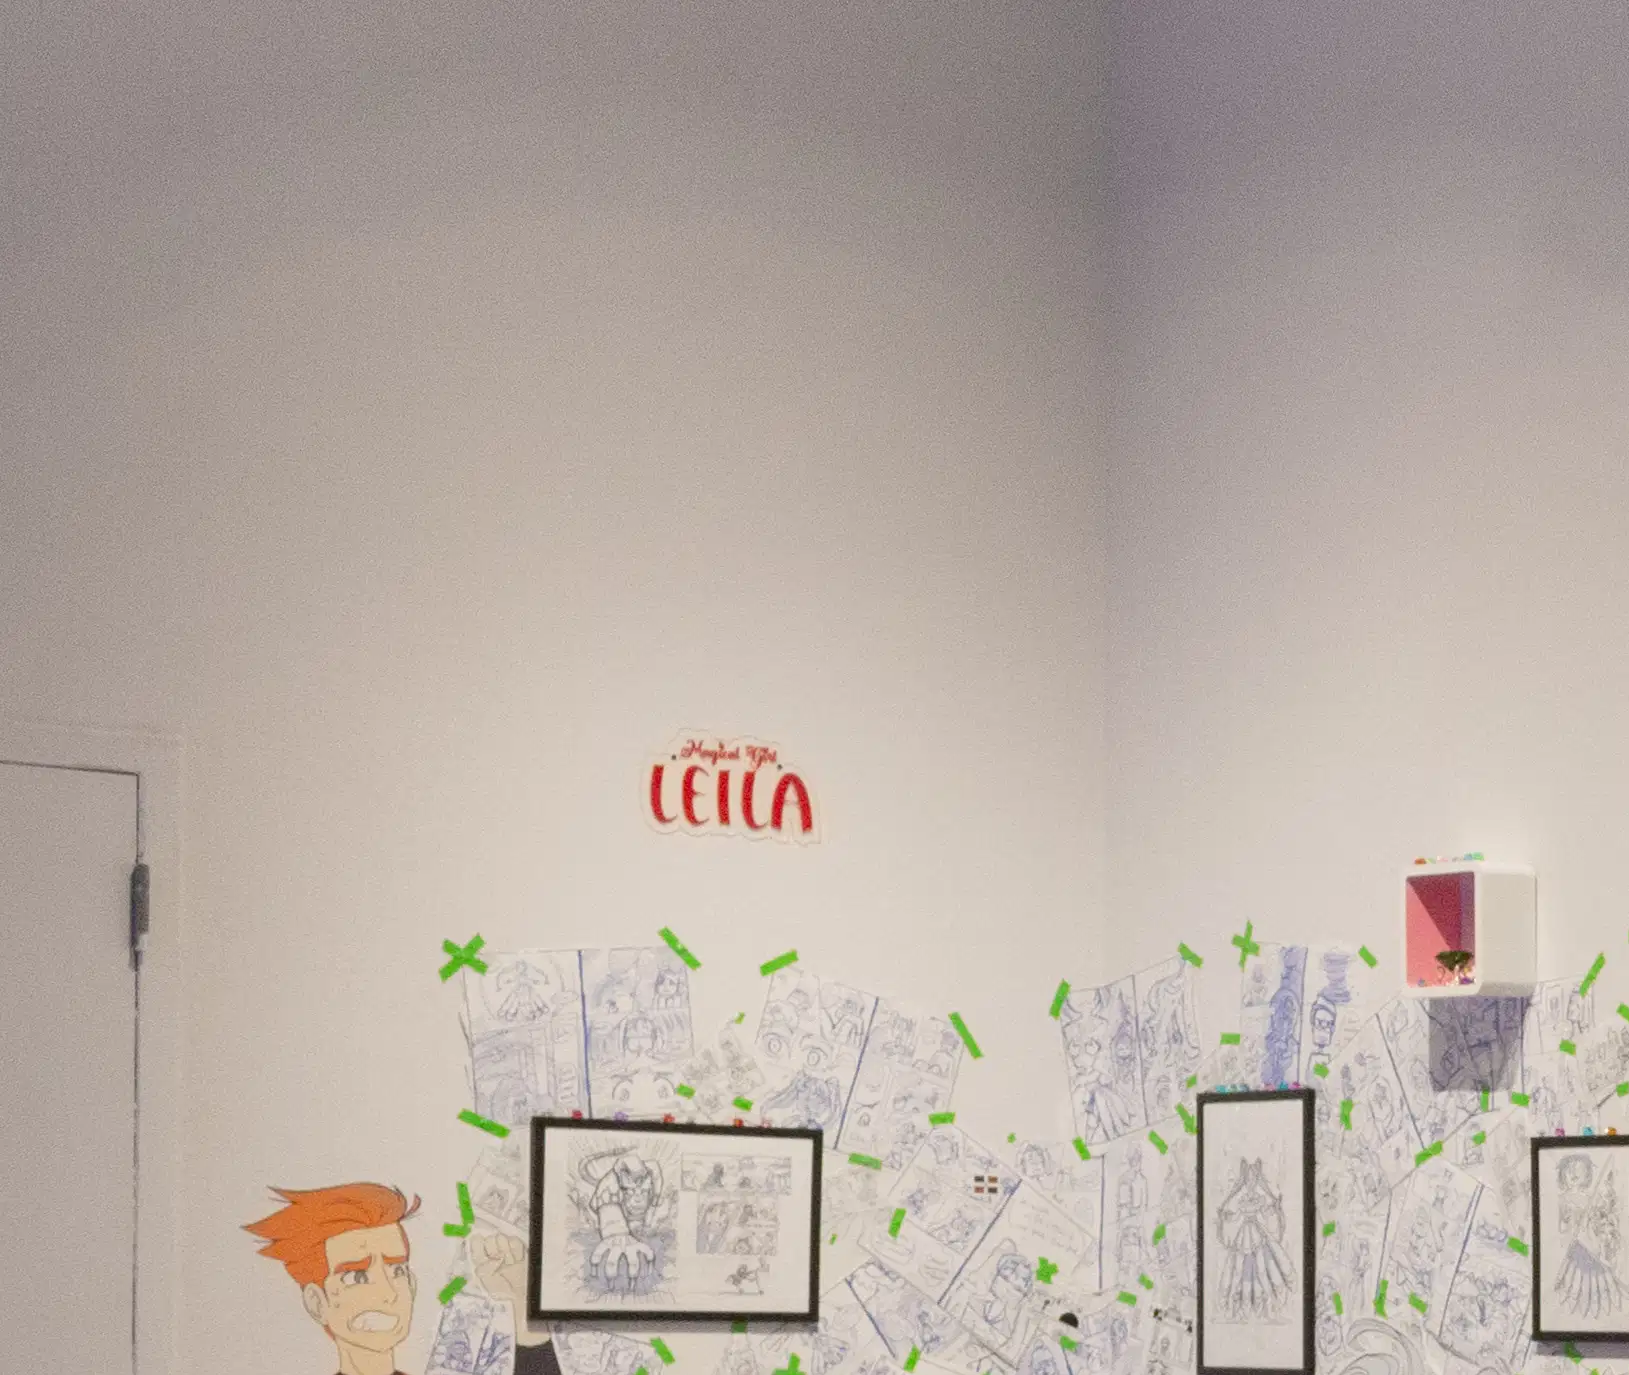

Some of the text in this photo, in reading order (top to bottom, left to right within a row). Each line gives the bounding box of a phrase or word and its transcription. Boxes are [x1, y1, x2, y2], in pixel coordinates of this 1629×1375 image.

[680, 738, 777, 769] Magical Girl
[650, 762, 814, 834] LEILA
